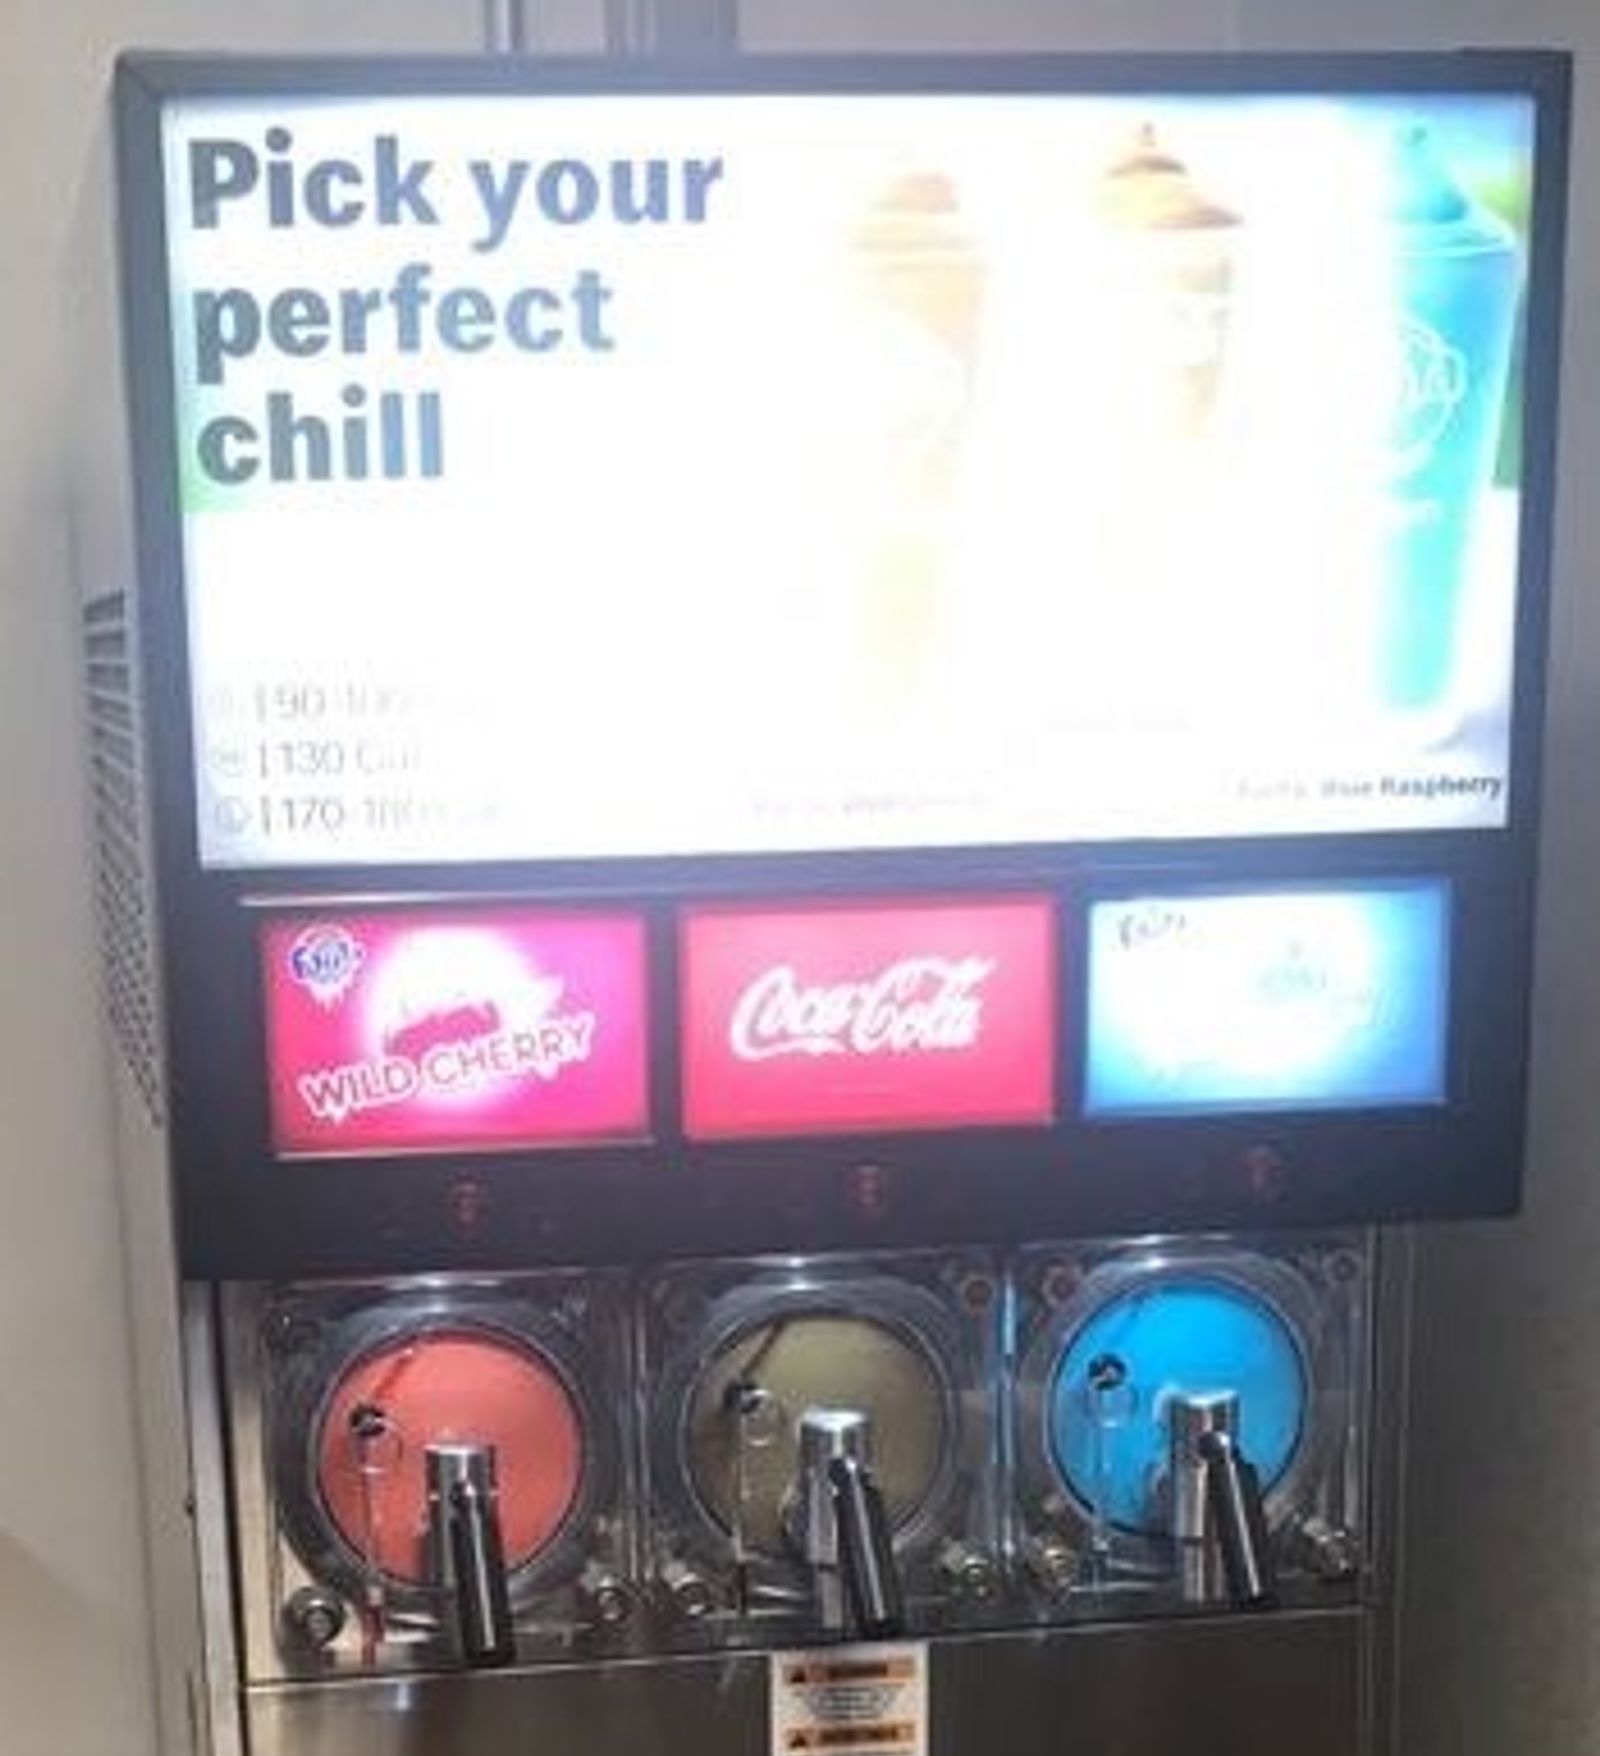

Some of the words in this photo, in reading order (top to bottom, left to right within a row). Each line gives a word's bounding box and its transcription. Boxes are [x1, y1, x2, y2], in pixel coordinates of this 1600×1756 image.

[187, 127, 440, 230] Pick
[469, 156, 725, 252] your
[191, 262, 616, 385] perfect
[196, 384, 445, 484] chill
[1380, 772, 1502, 802] Raspberry
[730, 953, 996, 1063] Coca-Cola
[303, 1061, 415, 1112] WILD
[426, 1020, 593, 1087] CHERRY
